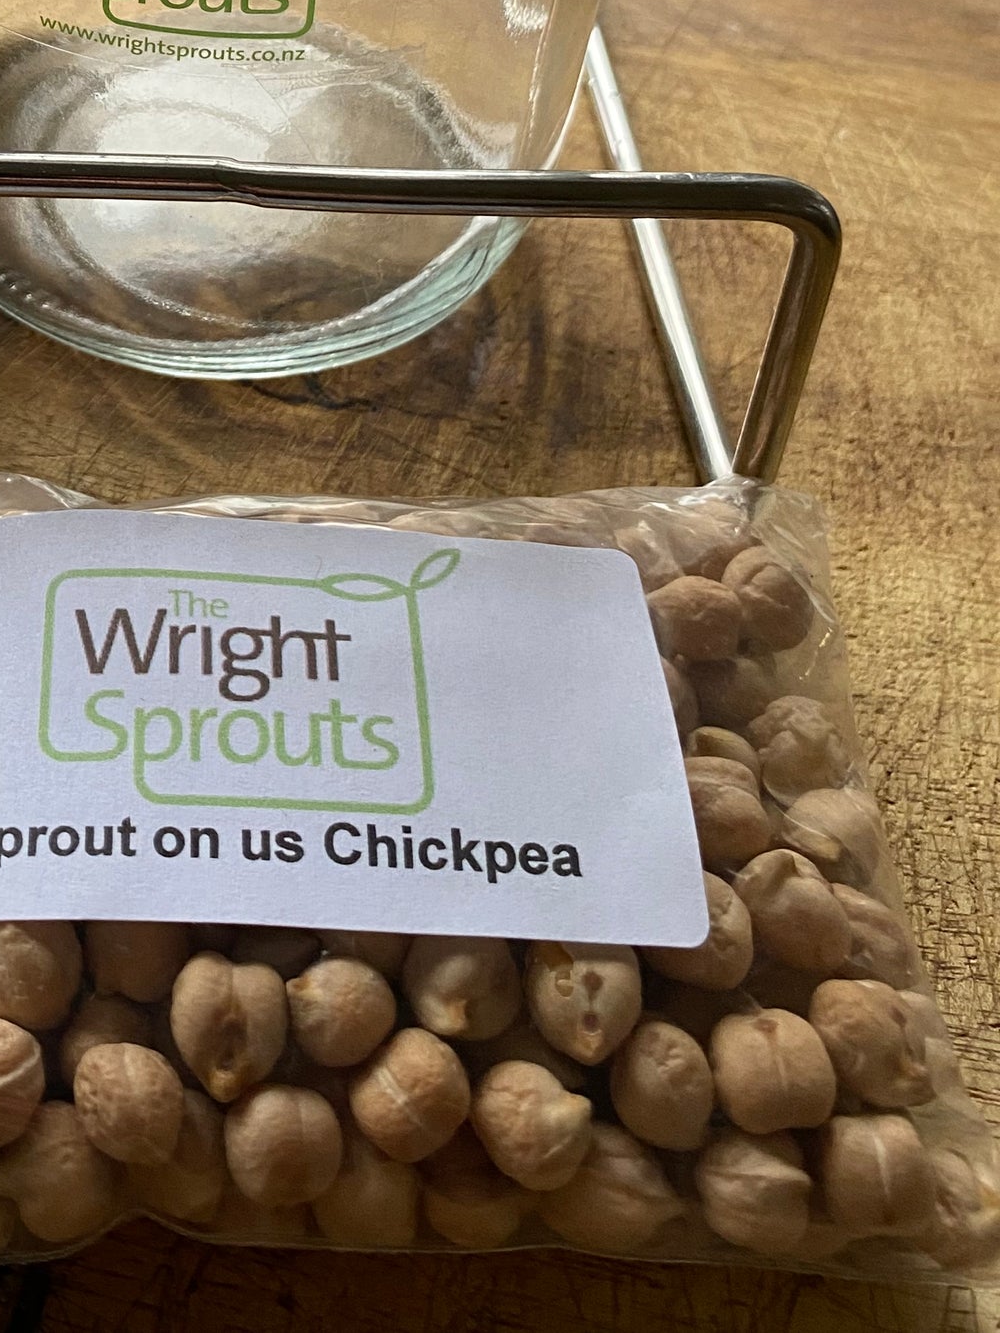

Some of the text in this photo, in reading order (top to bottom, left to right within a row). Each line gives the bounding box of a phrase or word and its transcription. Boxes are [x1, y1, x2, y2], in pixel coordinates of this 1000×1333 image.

[39, 15, 307, 62] www.wrightsprouts.co.nz
[168, 588, 230, 620] The
[74, 606, 353, 702] Wright
[82, 689, 401, 770] Sprouts
[152, 825, 221, 860] on
[240, 827, 305, 863] us
[323, 821, 584, 884] Chickpea
